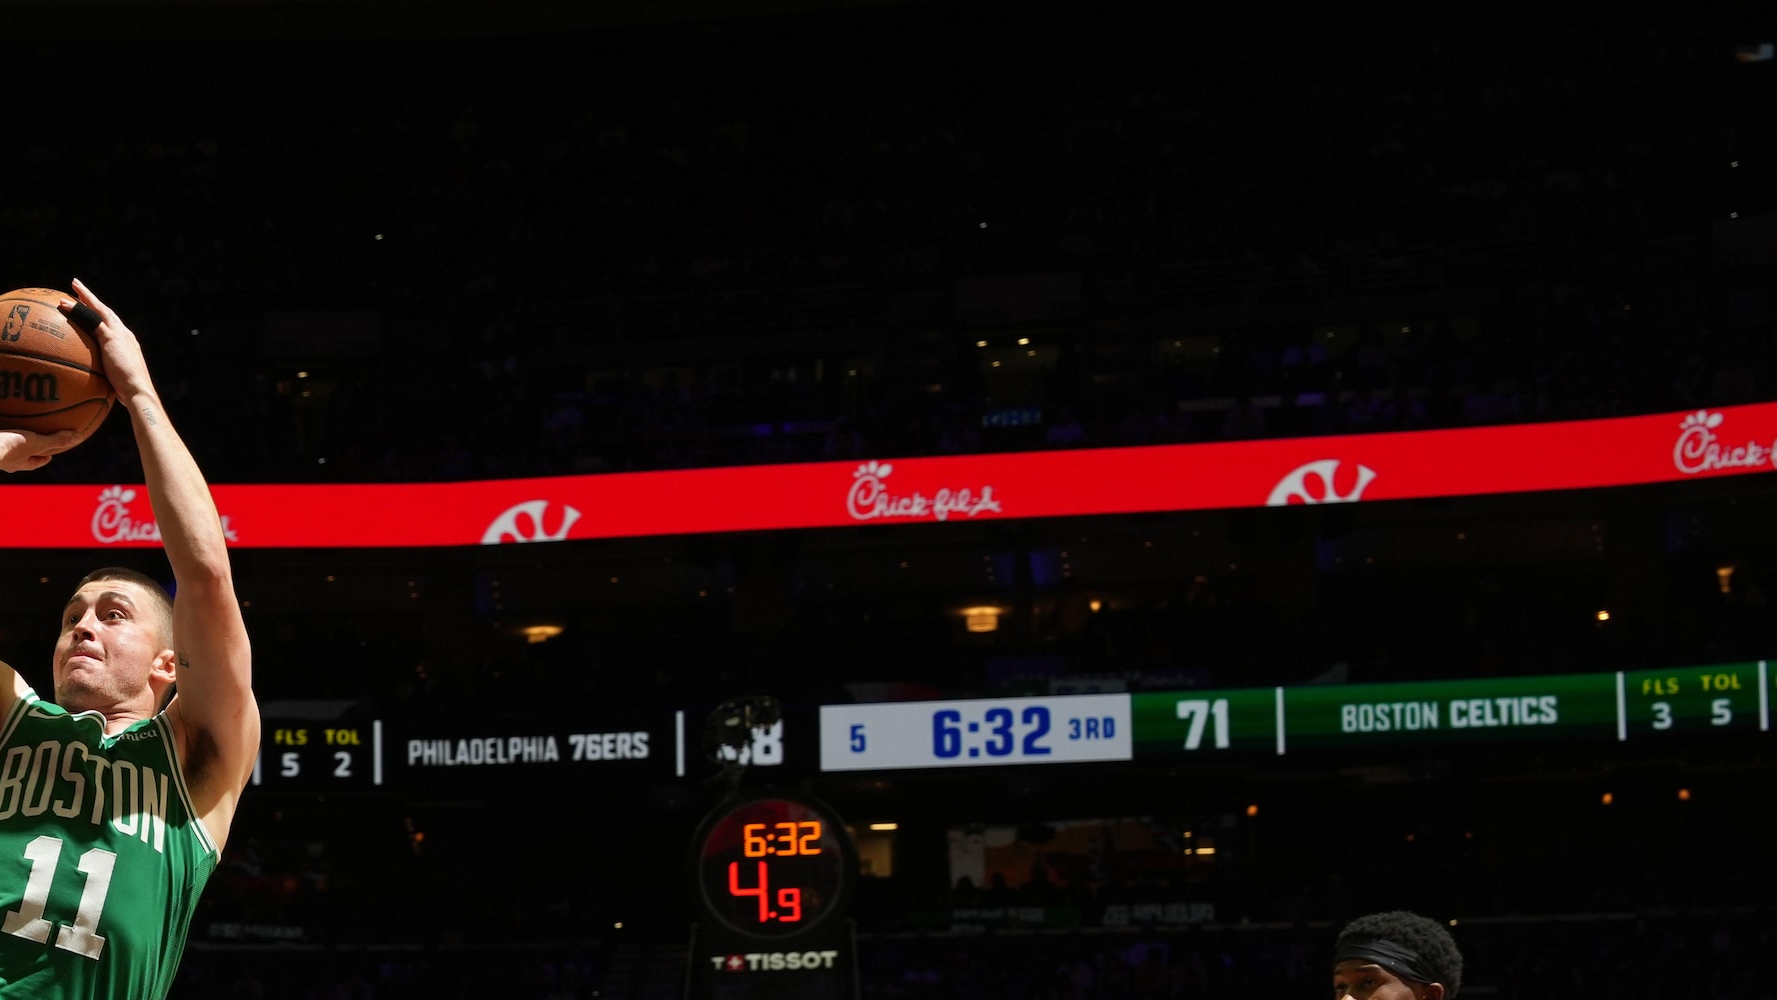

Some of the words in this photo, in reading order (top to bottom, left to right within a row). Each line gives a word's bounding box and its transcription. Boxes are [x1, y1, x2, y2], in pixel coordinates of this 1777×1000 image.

[847, 460, 1002, 522] Chick-fil-A
[1642, 677, 1679, 696] FLS
[1700, 673, 1741, 691] TOL
[1068, 716, 1116, 741] 3RD
[1176, 699, 1230, 750] 71
[1341, 702, 1439, 733] BOSTON
[1449, 695, 1559, 729] CELTICS
[1652, 702, 1673, 730] 3
[1711, 698, 1732, 726] 5
[120, 729, 158, 742] mica
[274, 729, 308, 746] FLS
[325, 728, 360, 745] TOL
[408, 736, 559, 766] PHILADELPHIA
[568, 731, 649, 761] 76ERS
[849, 724, 867, 755] 5
[932, 706, 1052, 760] 6:32
[281, 752, 301, 777] 5
[333, 751, 352, 778] 2
[743, 820, 822, 858] 6:32
[0, 835, 118, 961] 11
[728, 860, 802, 923] 4.9
[744, 950, 839, 971] TISSOT
